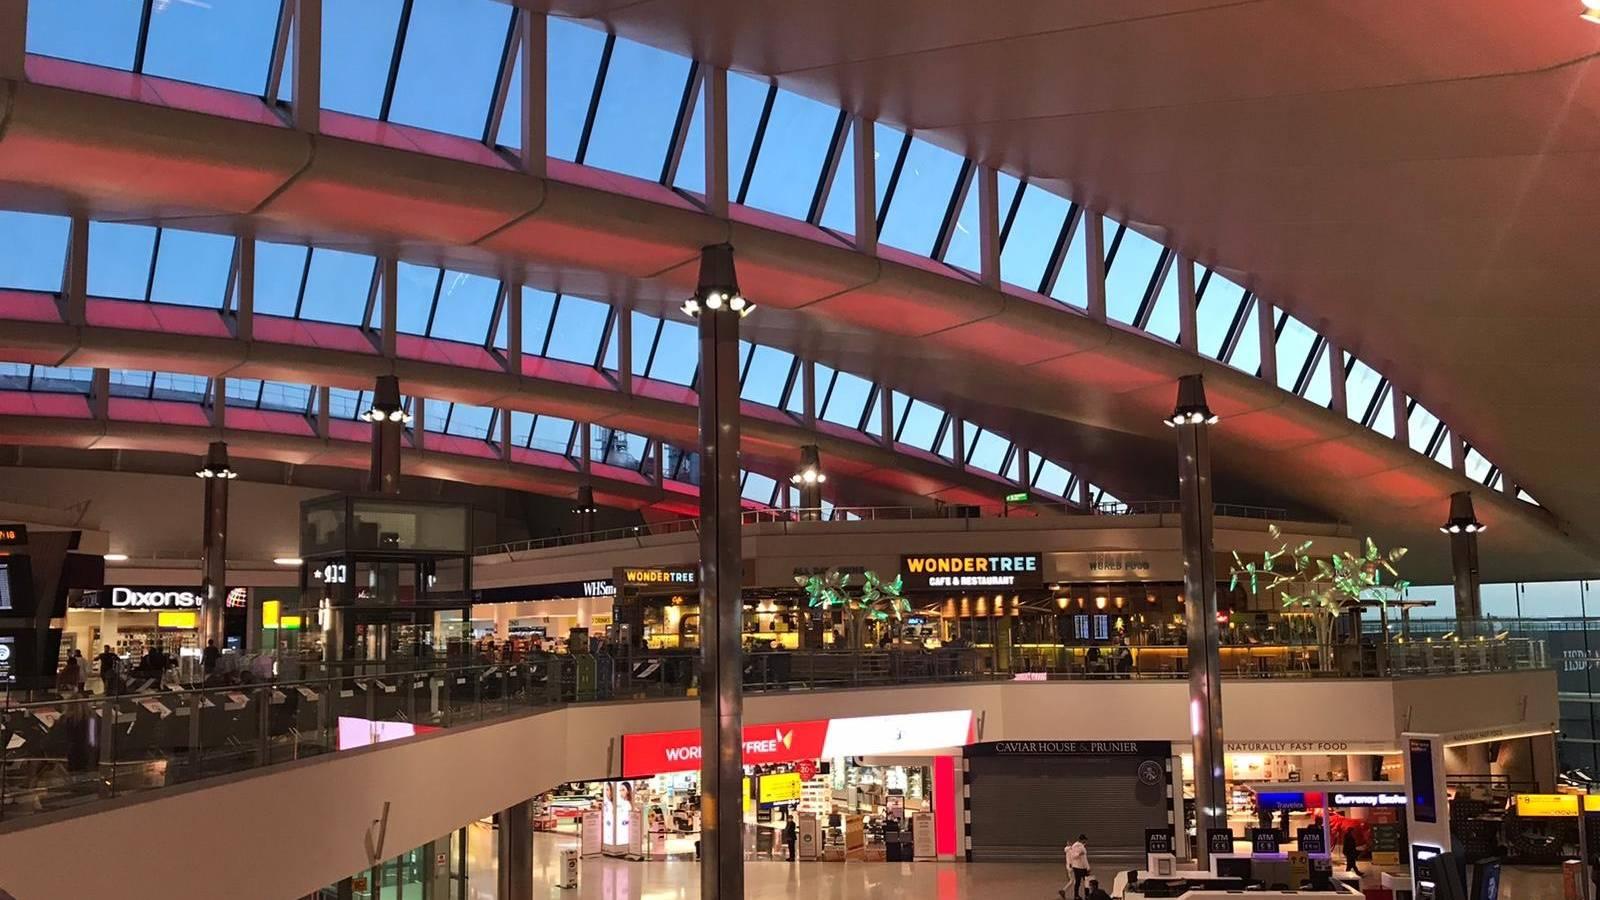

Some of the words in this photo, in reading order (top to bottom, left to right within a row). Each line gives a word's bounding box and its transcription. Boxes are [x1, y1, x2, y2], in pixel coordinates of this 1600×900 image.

[907, 556, 1036, 572] WONDERTREE
[626, 571, 695, 582] WONDERTREE
[928, 576, 951, 586] CAFE
[961, 576, 1014, 585] RESTAURANT
[112, 587, 194, 607] Dixons
[996, 742, 1037, 752] CAVIAR
[1039, 742, 1076, 752] HOUSE
[1091, 742, 1138, 752] PRUNIER
[1227, 742, 1286, 751] NATURALLY
[1290, 742, 1314, 751] FAST
[1318, 742, 1348, 751] FOOD
[1150, 833, 1167, 841] ATM
[1212, 833, 1229, 841] ATM
[1257, 833, 1274, 841] ATM
[1303, 833, 1320, 841] ATM
